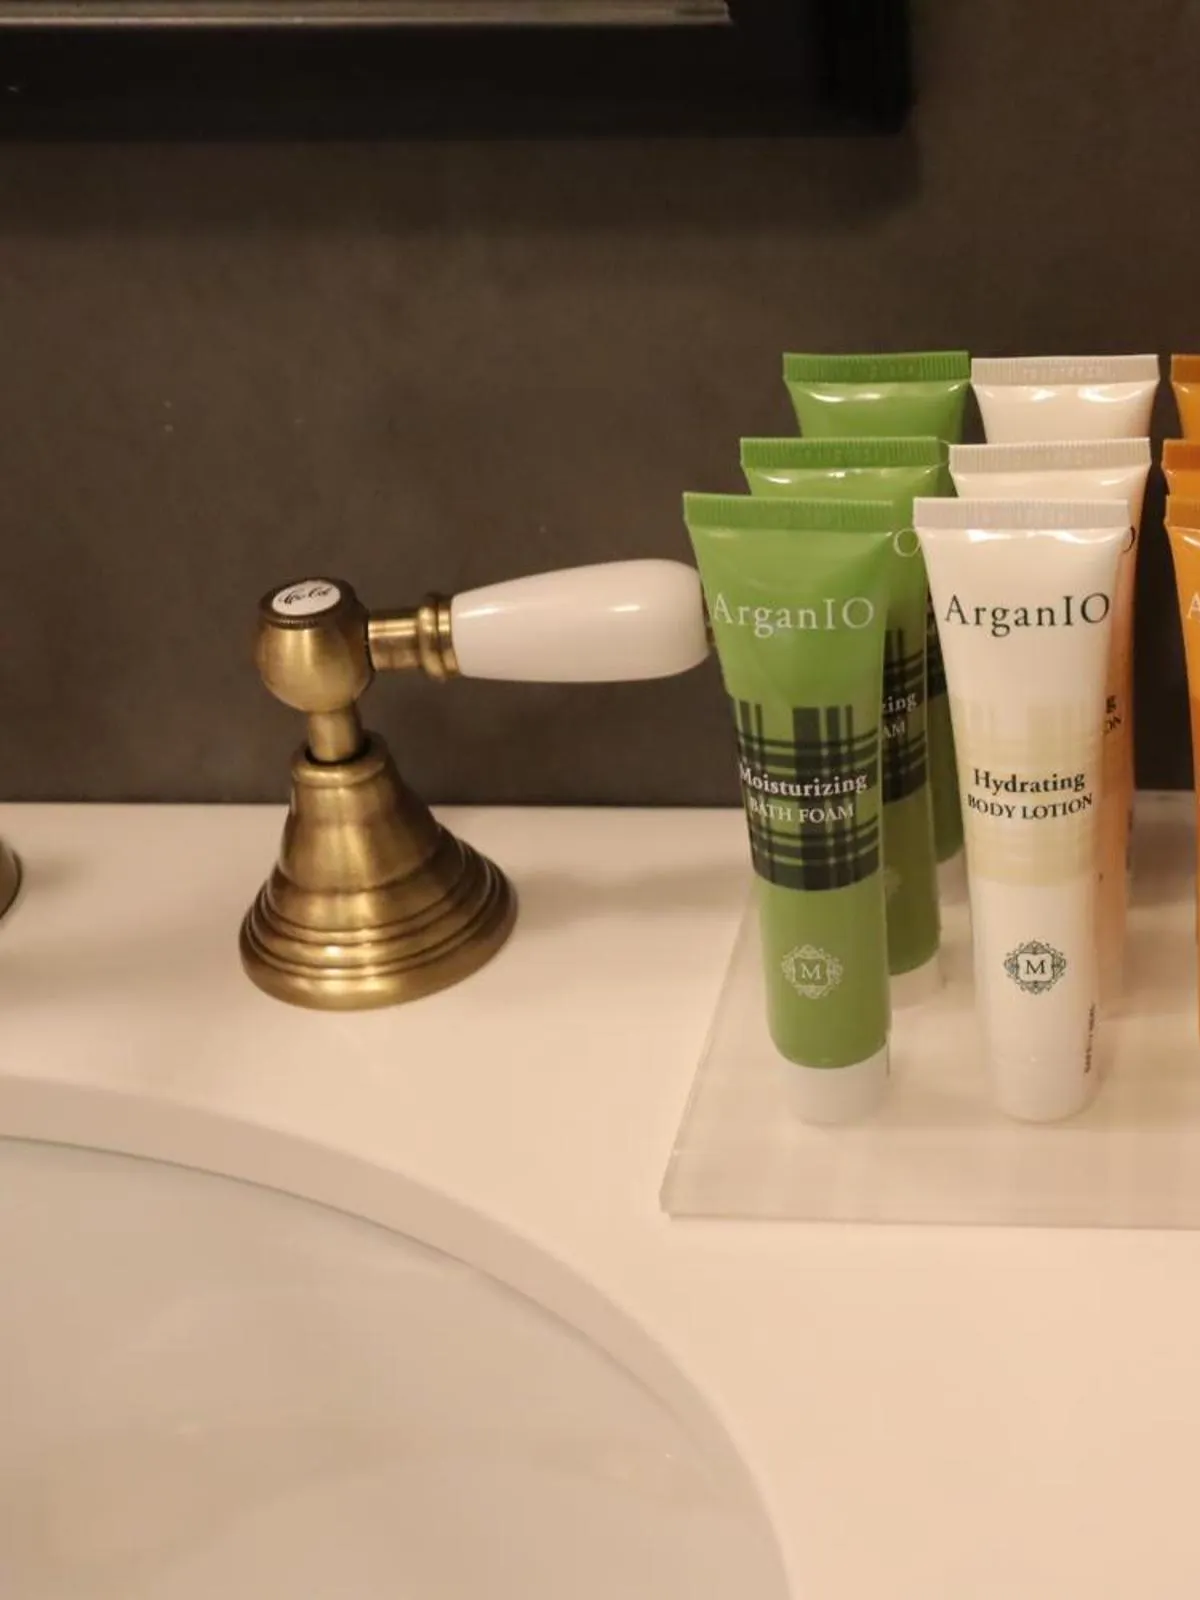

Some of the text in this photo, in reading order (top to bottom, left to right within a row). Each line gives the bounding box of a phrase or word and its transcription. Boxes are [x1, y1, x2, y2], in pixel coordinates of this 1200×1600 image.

[713, 593, 875, 639] ArganIO
[945, 592, 1110, 638] ArganIO
[739, 762, 868, 797] Moisturizing
[973, 767, 1085, 796] Hydrating
[798, 802, 855, 824] FOAM
[966, 792, 1093, 821] BODY LOTION
